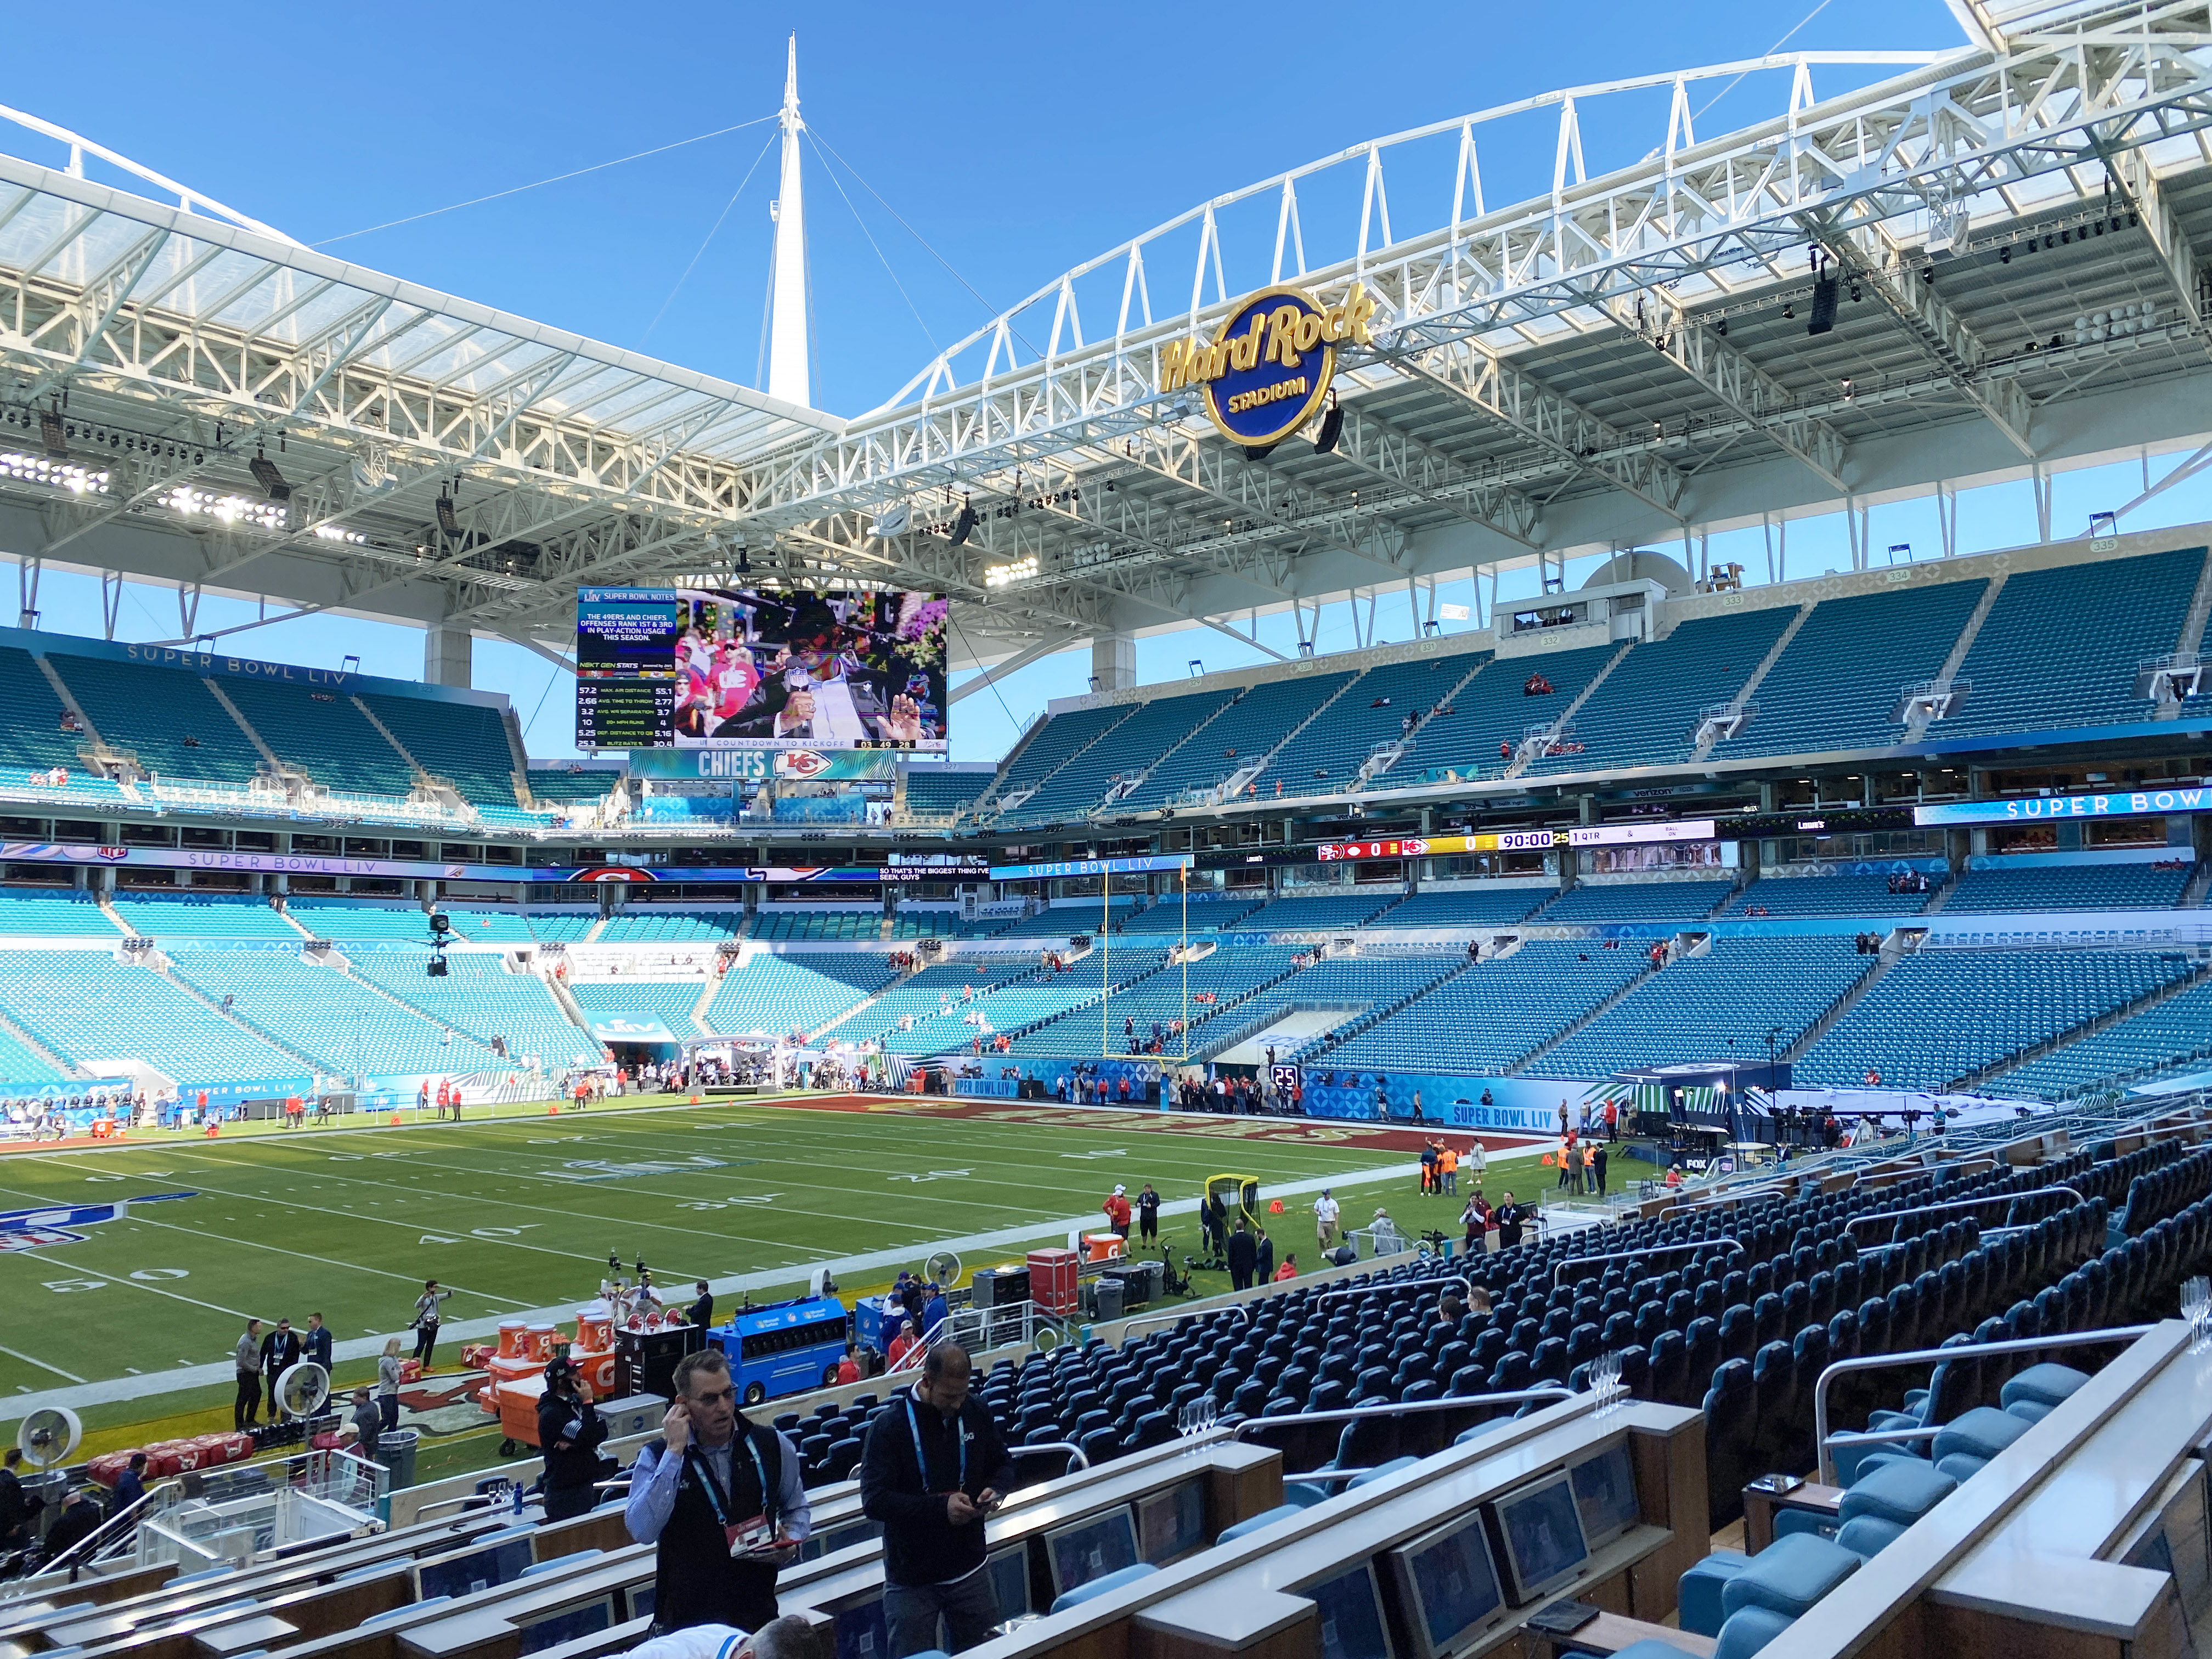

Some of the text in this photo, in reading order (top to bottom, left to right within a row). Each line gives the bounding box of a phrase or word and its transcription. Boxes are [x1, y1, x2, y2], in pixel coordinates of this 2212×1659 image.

[1160, 282, 1375, 393] Hard Rock
[1228, 376, 1305, 413] STADIUM
[2094, 540, 2114, 550] 335
[1890, 572, 1907, 580] 334
[1726, 596, 1740, 605] 333
[1544, 636, 1558, 645] 332
[127, 646, 346, 685] SUPER BOWL LIV
[698, 751, 818, 777] CHIEFS KC
[1633, 787, 1672, 797] verizon
[2007, 790, 2204, 818] SUPER BOW
[1465, 836, 1476, 850] 0
[1504, 833, 1569, 847] 90:00 25
[1574, 833, 1577, 842] 1
[1582, 832, 1600, 840] QTR
[99, 847, 125, 856] NFL
[1370, 843, 1381, 856] 0
[189, 854, 375, 872] SUPER BOWL LIV
[1028, 857, 1152, 876] SUPER BOWL LIV
[1276, 1069, 1294, 1086] 25
[188, 1087, 228, 1097] SUPER
[275, 1084, 295, 1092] LIV
[954, 1081, 1010, 1096] UPER BOWL LIV
[1454, 1106, 1551, 1128] SUPER BOWL LIV
[97, 1123, 106, 1132] G
[1686, 1159, 1707, 1169] FOX
[887, 1170, 970, 1182] 20
[675, 1195, 773, 1211] 30
[418, 1227, 521, 1245] 40
[1108, 1244, 1118, 1257] G
[40, 1268, 190, 1293] 50
[515, 1332, 523, 1344] G
[598, 1326, 606, 1337] G
[540, 1335, 550, 1347] G
[596, 1359, 615, 1387] G
